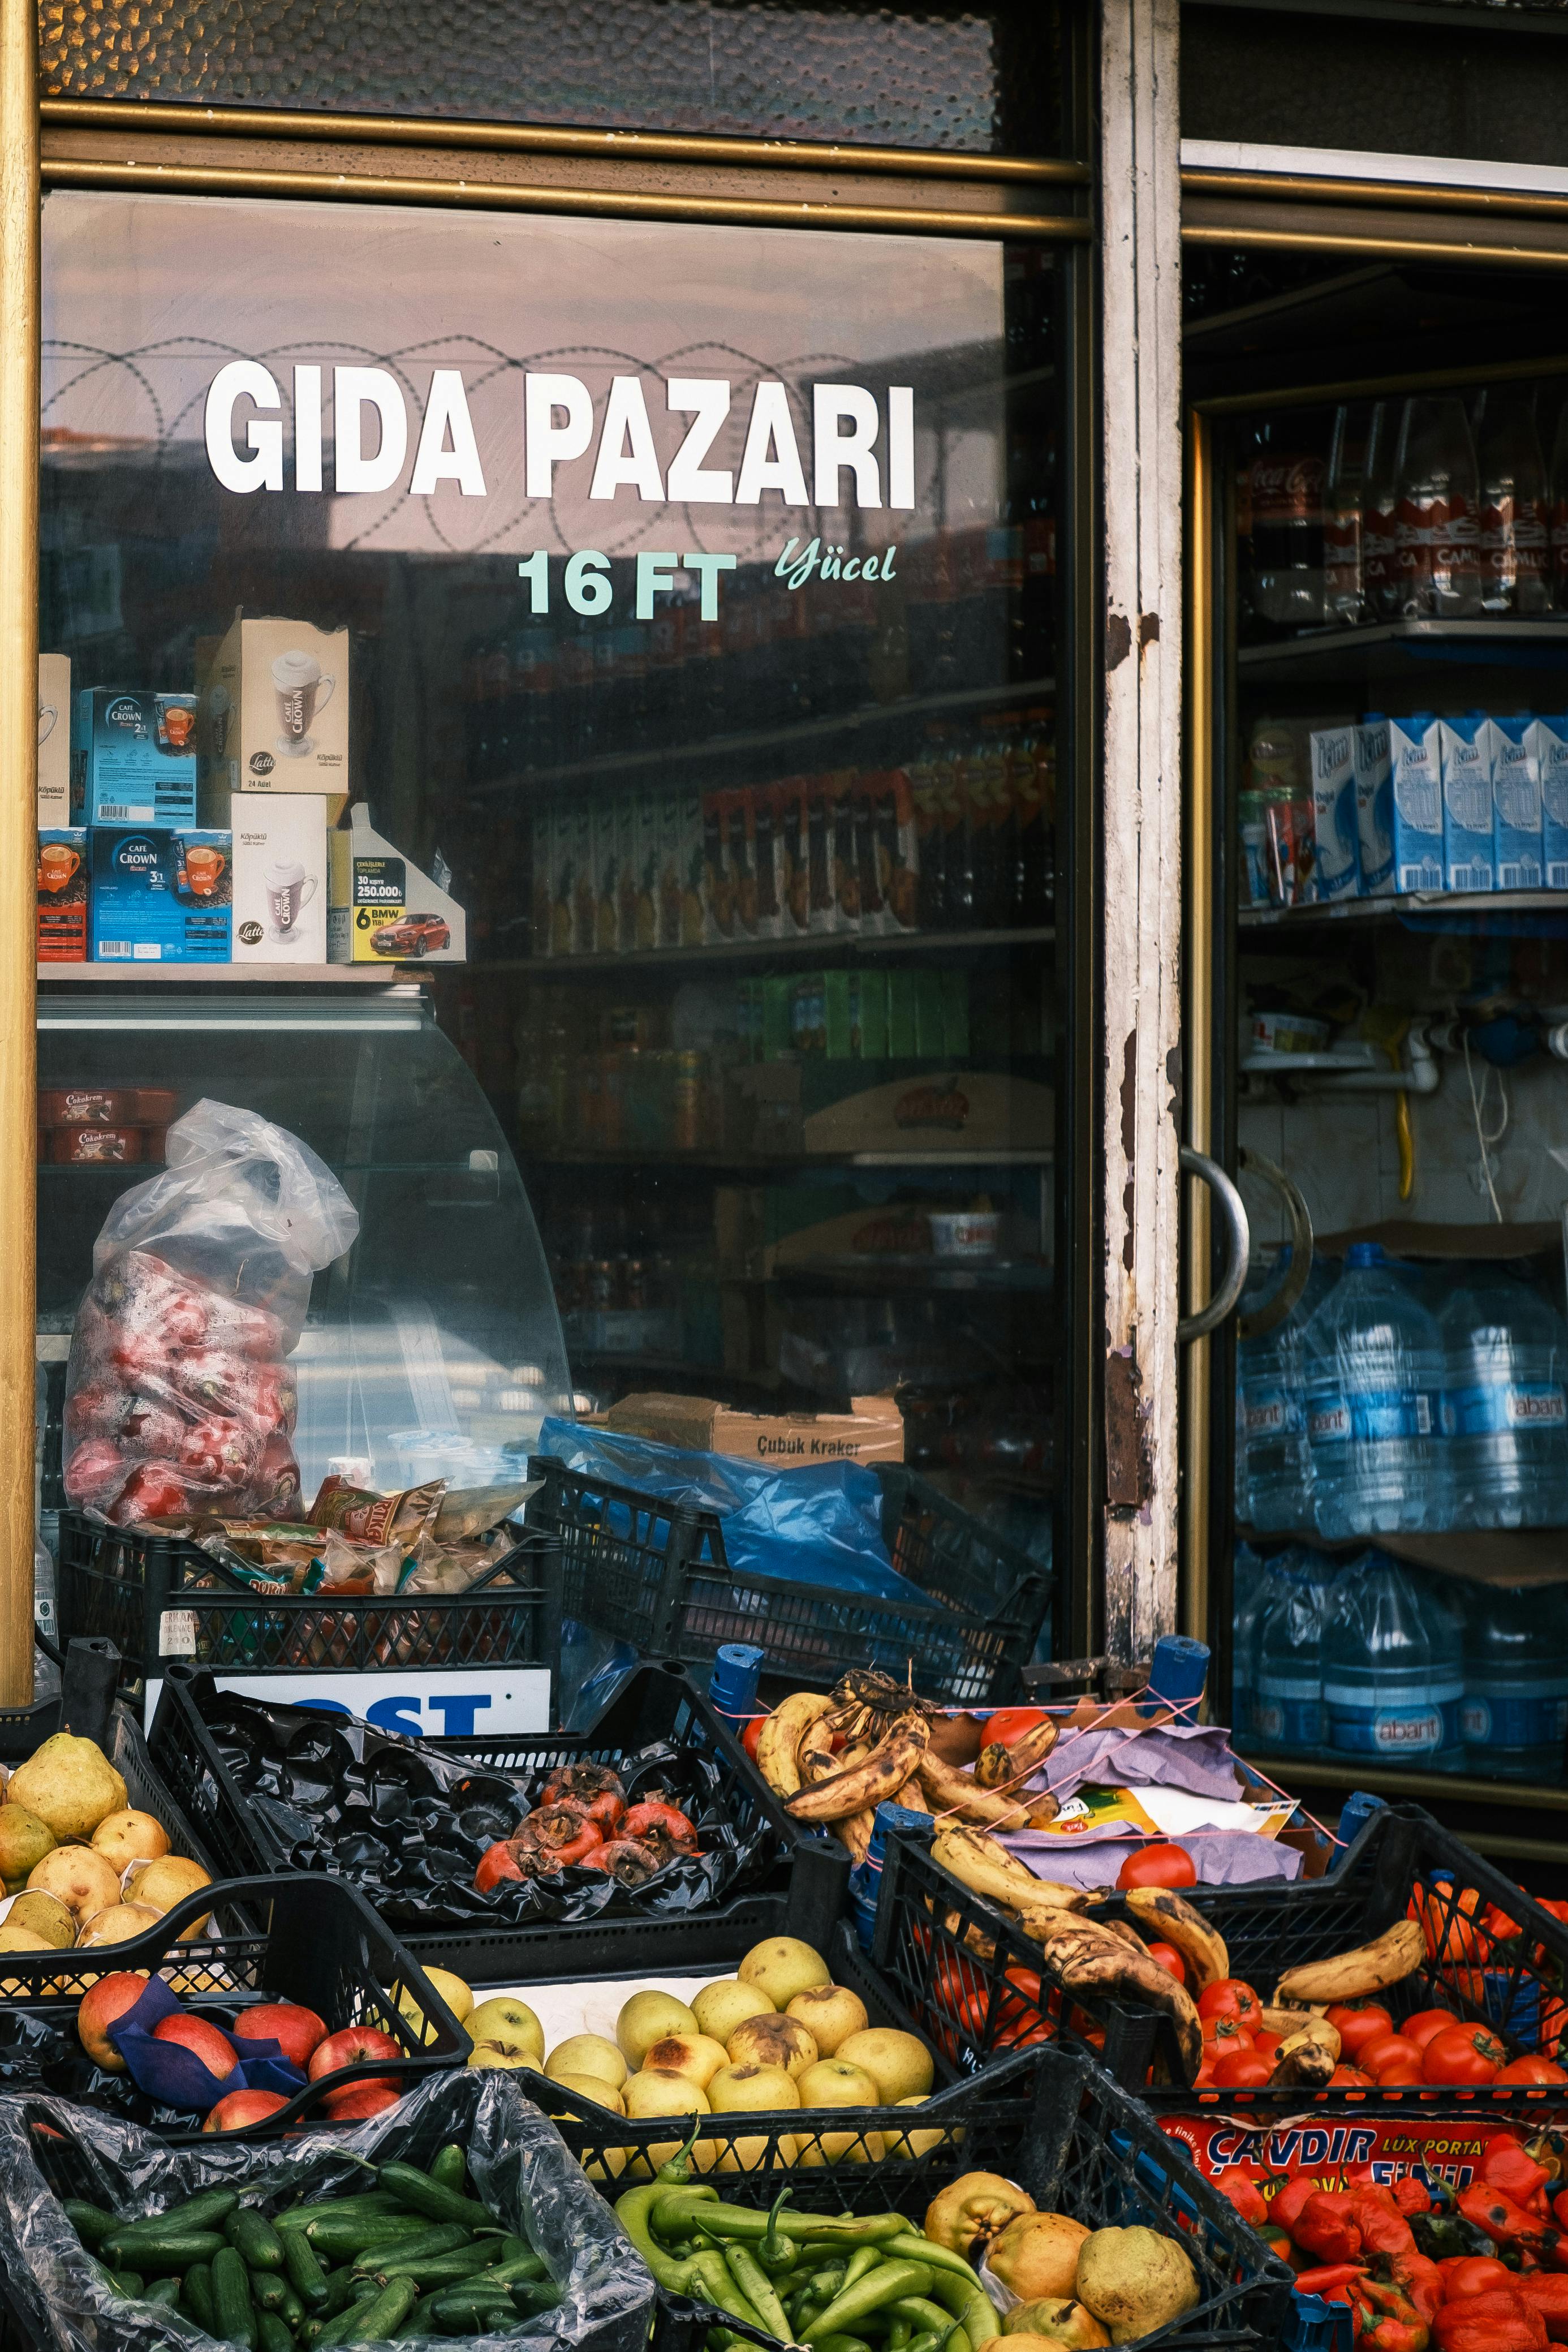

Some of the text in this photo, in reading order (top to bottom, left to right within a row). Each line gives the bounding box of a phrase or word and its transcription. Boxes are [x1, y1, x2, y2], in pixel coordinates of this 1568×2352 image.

[204, 359, 915, 510] GIDA PAZARI
[774, 536, 897, 590] Yücel
[518, 550, 738, 622] 16 FT
[111, 711, 141, 721] CROWN
[292, 690, 303, 733] CROWN
[249, 754, 276, 771] Latte
[119, 853, 157, 865] CROWN
[357, 876, 368, 884] 30
[281, 888, 290, 925] CROWN
[356, 908, 399, 930] 6 BMW
[236, 923, 265, 940] Latte
[1515, 1394, 1562, 1416] abant
[757, 1435, 861, 1456] Çubuk Kraker
[1380, 1719, 1436, 1740] abant
[1207, 2127, 1377, 2175] ÇAVDIR
[1381, 2134, 1489, 2157] LÜX PORTA
